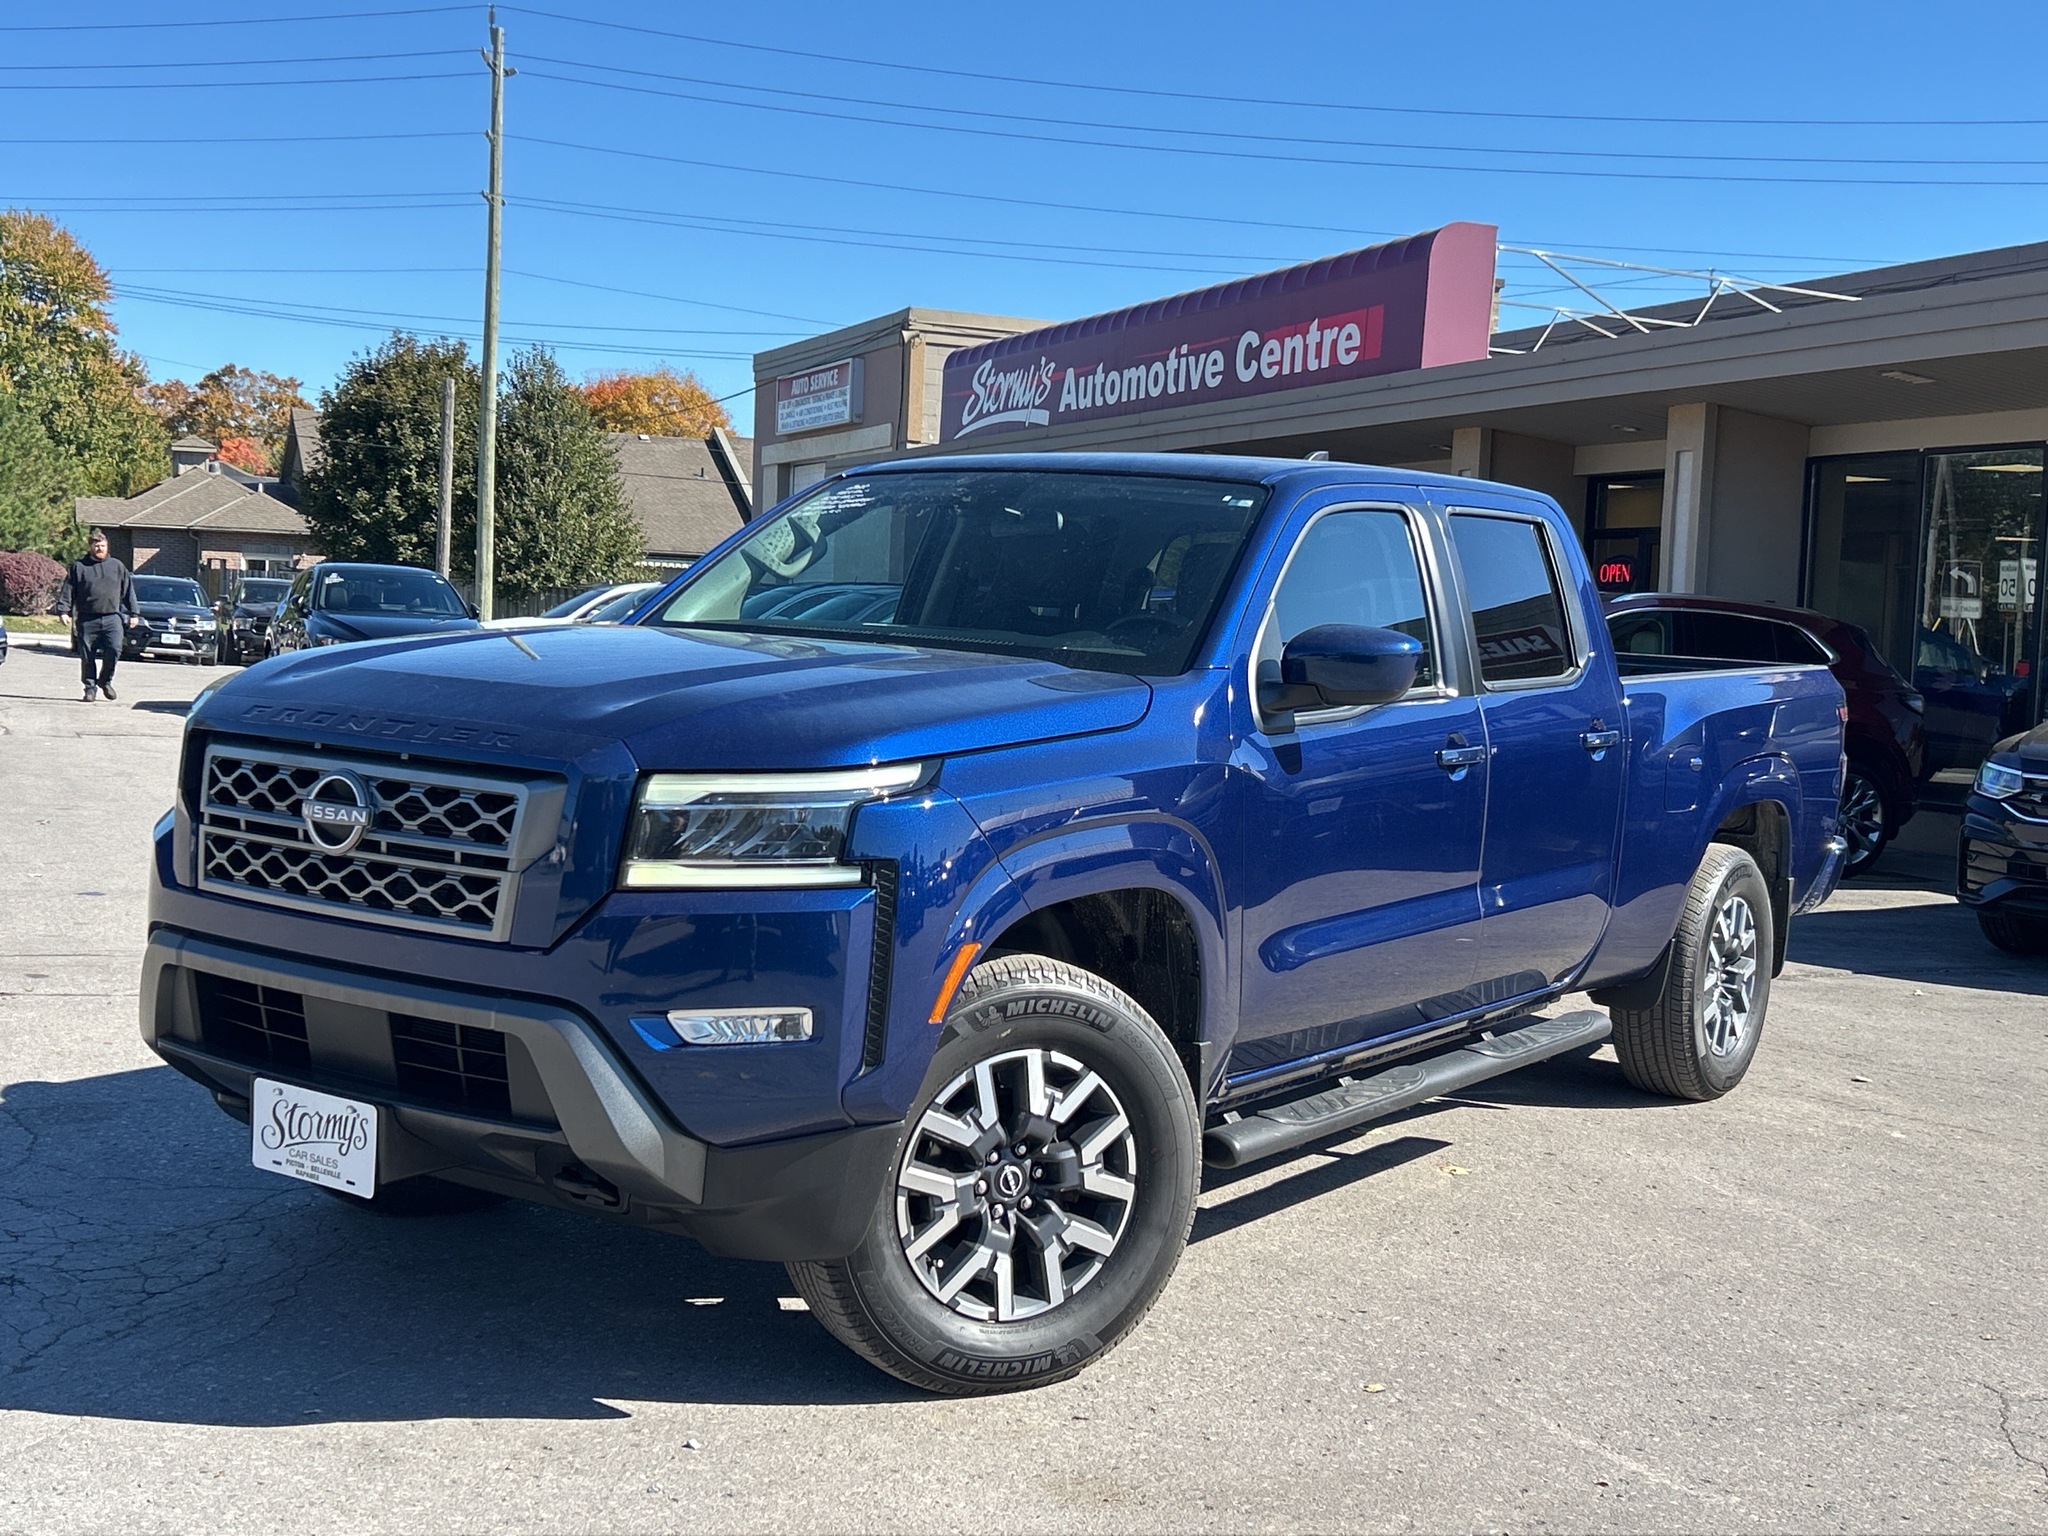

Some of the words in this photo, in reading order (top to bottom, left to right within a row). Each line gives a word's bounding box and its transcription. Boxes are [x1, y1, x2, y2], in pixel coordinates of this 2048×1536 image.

[791, 376, 809, 396] AUTO
[810, 368, 839, 391] SERVICE
[961, 355, 1056, 427] Stormy's
[1058, 343, 1225, 413] Automotive
[1235, 317, 1361, 384] Centre
[1600, 563, 1631, 583] OPEN
[240, 703, 521, 752] FRONTIER
[302, 802, 367, 824] NISSAN
[1005, 999, 1114, 1029] MICHELIN
[261, 1098, 369, 1157] Stormy's
[288, 1148, 308, 1162] CAR
[309, 1152, 339, 1170] SALES
[310, 1165, 342, 1180] BELLEVILLE
[937, 1351, 1053, 1377] MICHELIN
